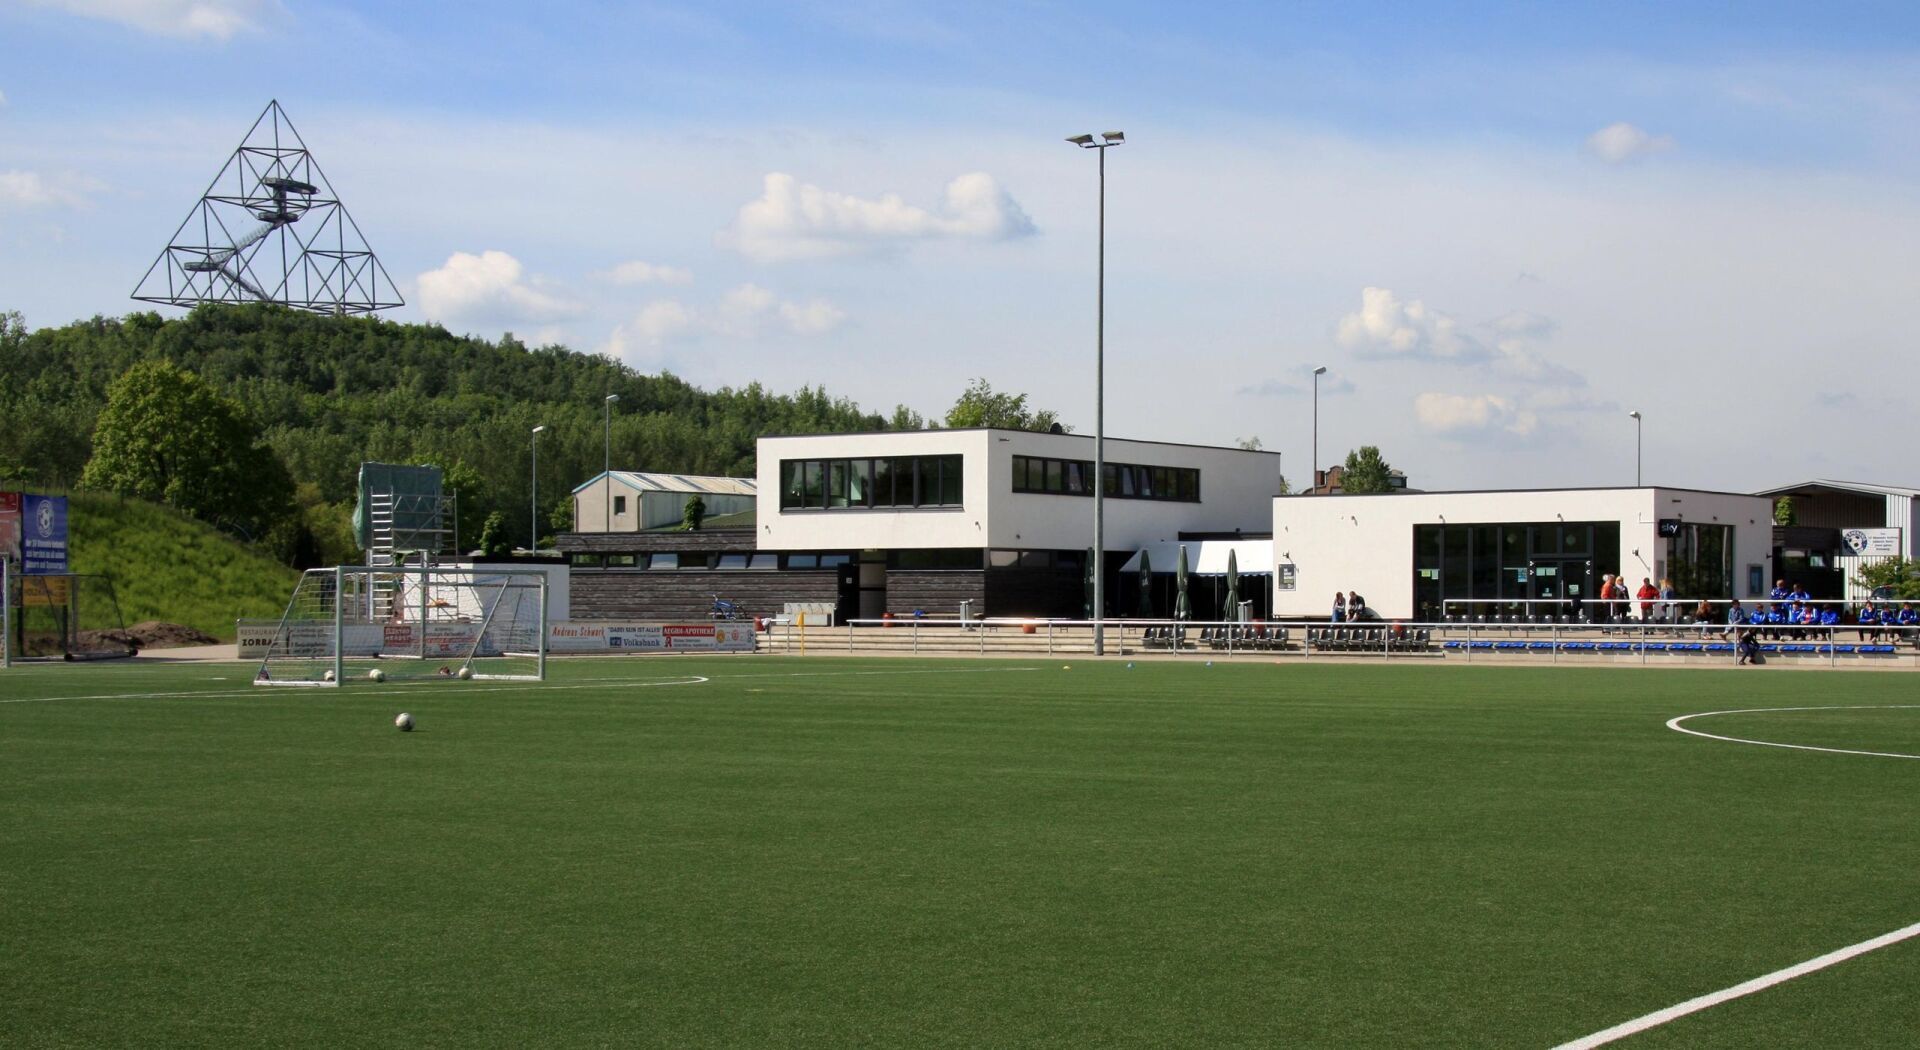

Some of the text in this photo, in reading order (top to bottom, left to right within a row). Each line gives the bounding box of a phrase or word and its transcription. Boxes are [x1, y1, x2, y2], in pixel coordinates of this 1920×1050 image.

[1661, 523, 1678, 534] sky
[242, 638, 279, 647] ZORBA
[623, 638, 660, 647] Volksbank
